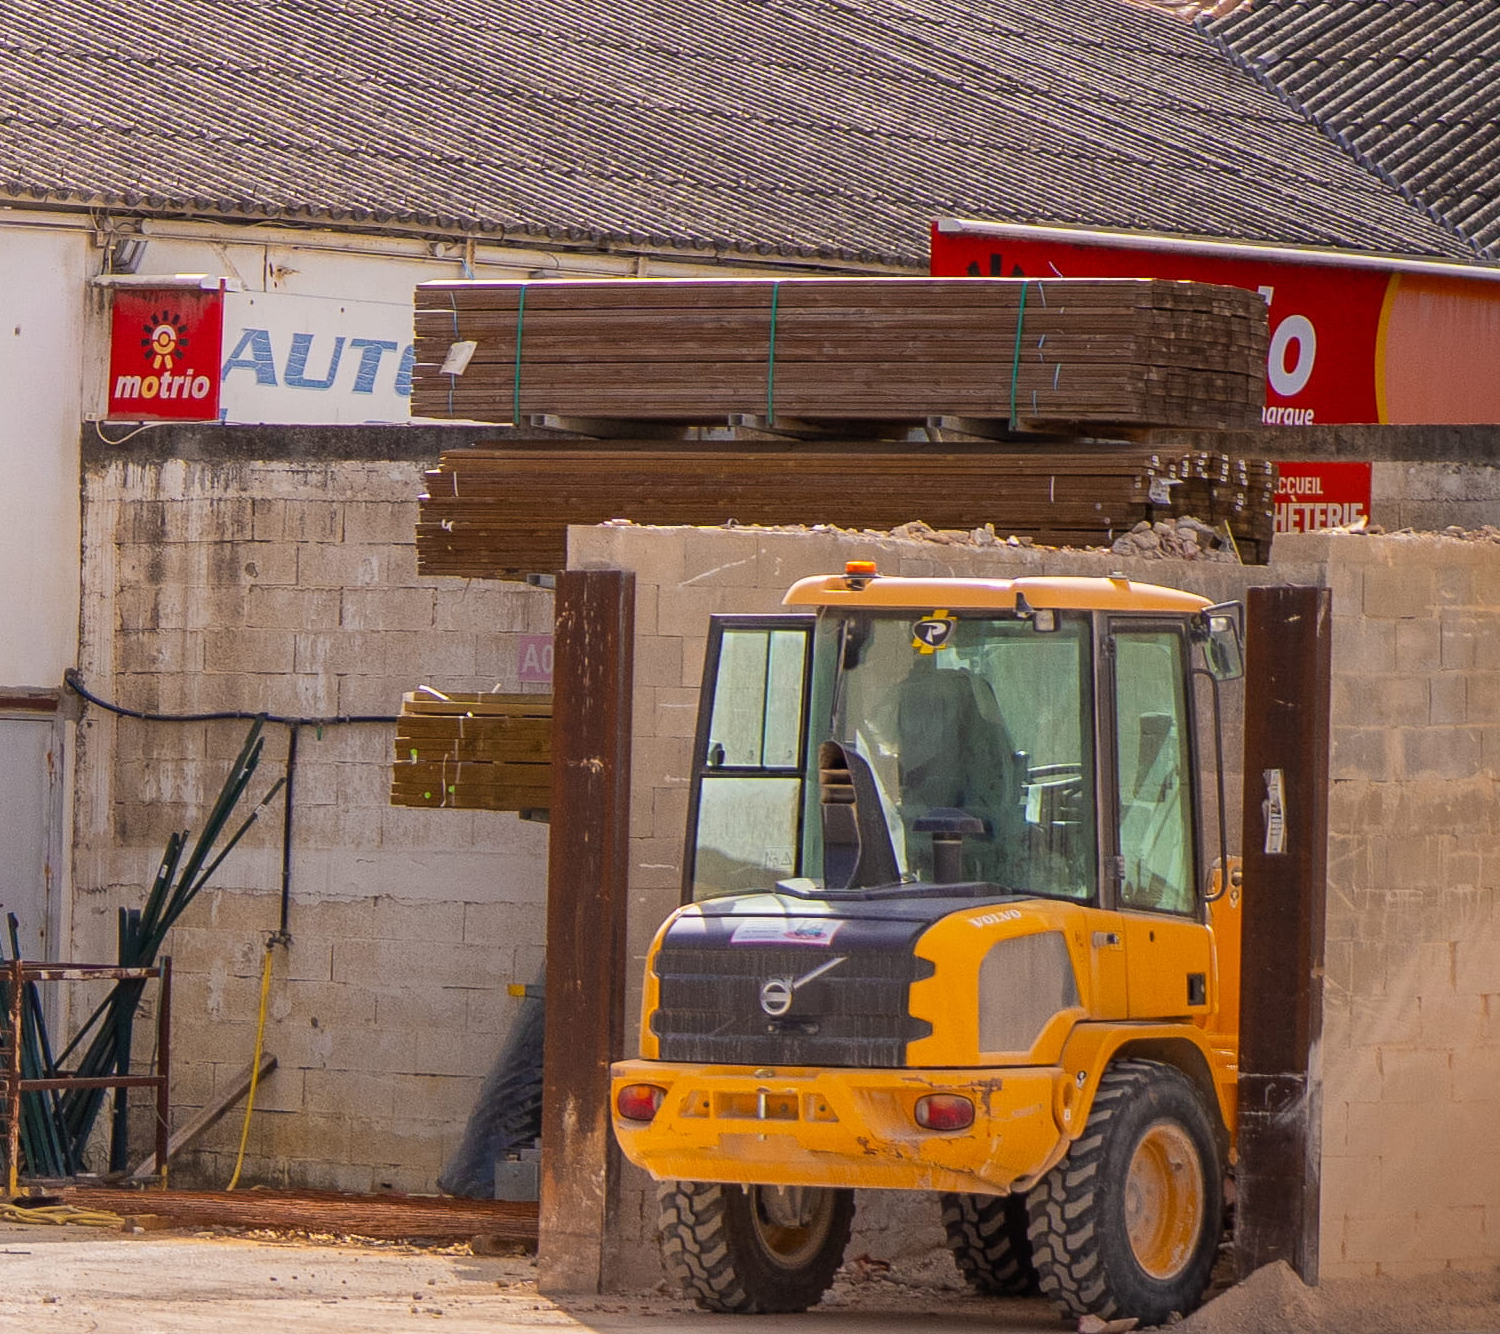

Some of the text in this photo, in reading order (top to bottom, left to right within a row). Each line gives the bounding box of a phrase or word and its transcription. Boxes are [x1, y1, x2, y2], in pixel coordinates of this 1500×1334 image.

[114, 369, 211, 398] motrio
[1274, 477, 1324, 495] CCUEIL
[967, 909, 1022, 929] VOLVO
